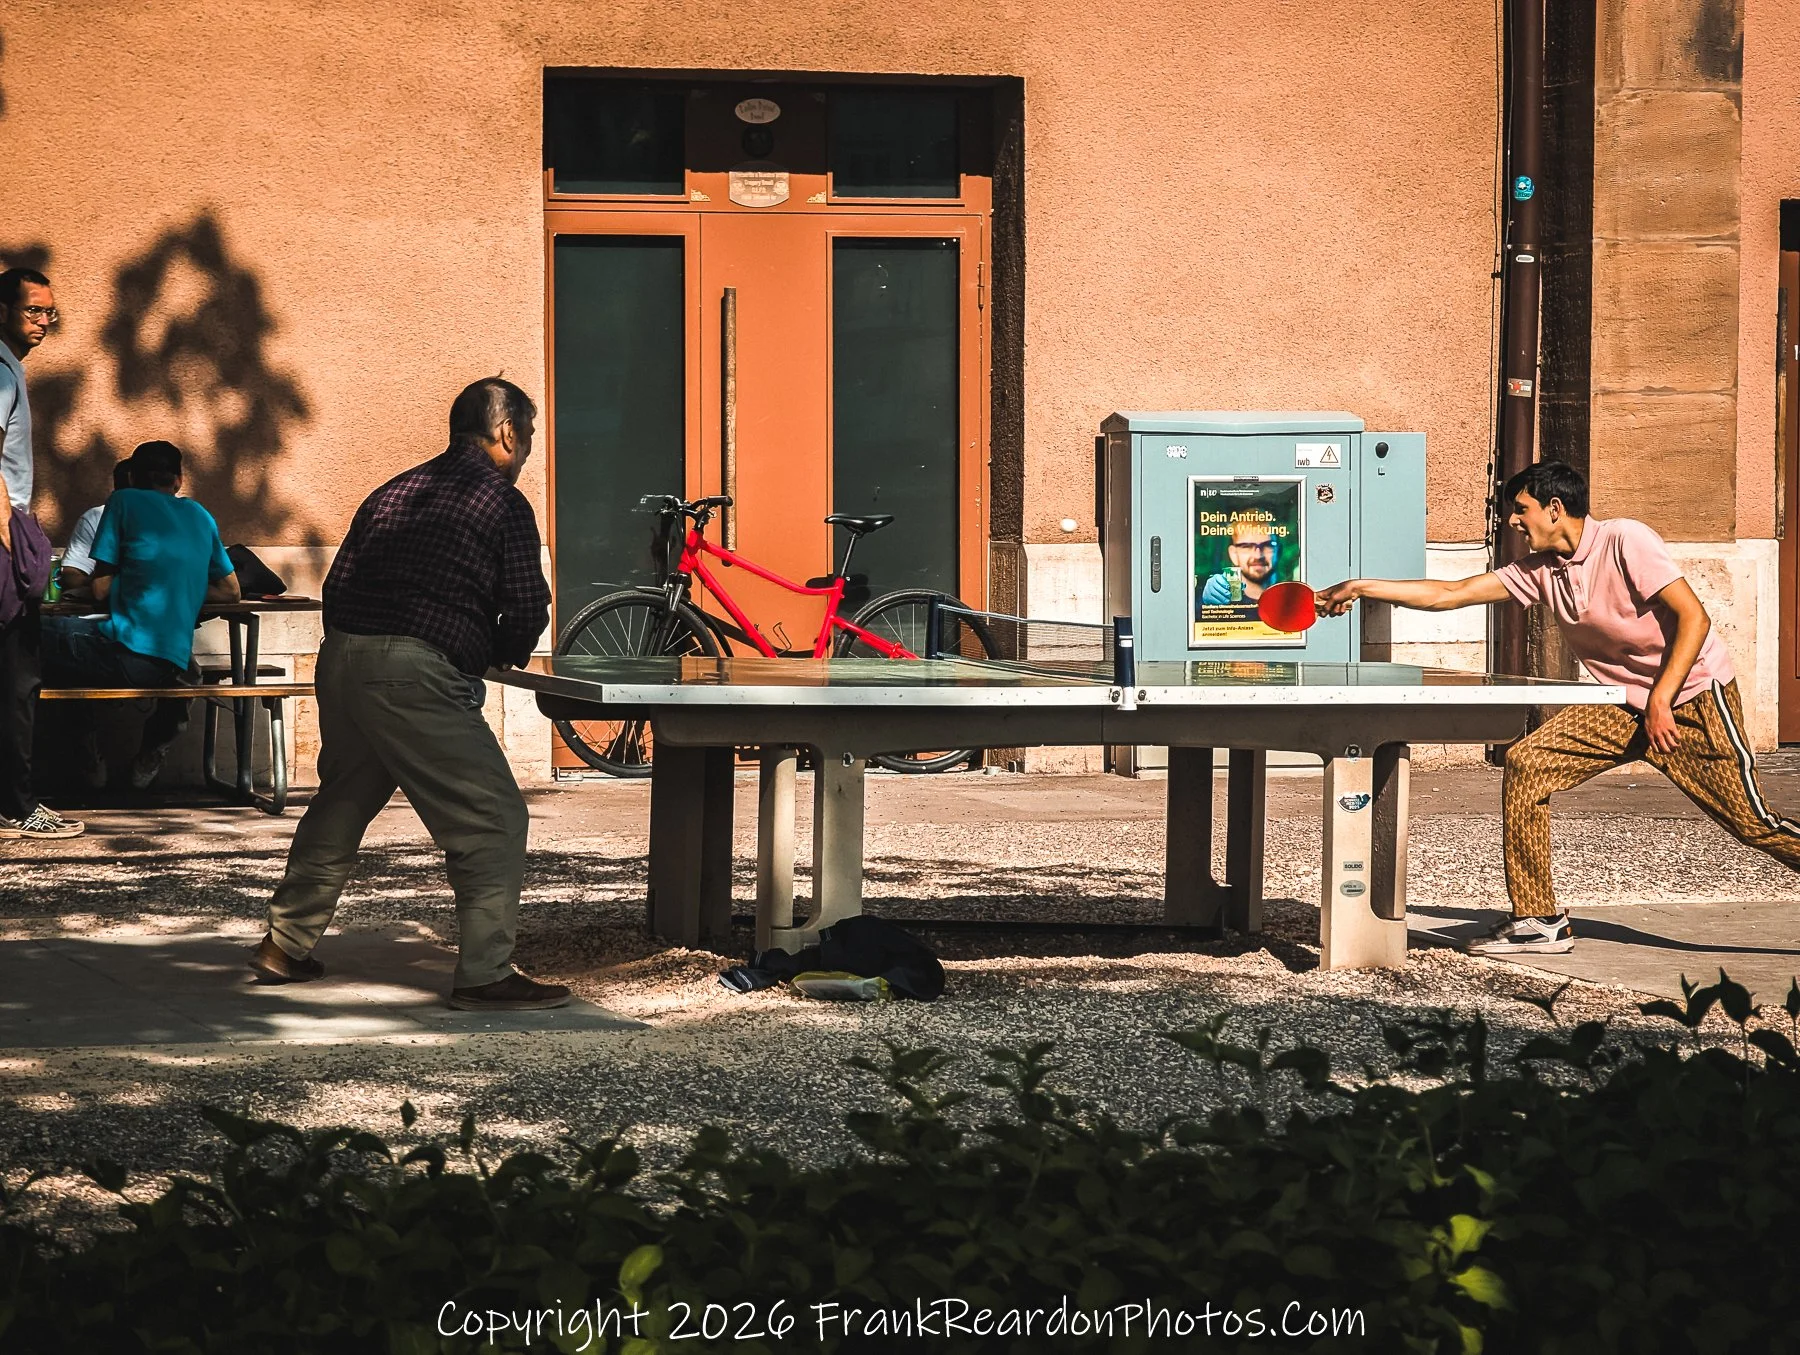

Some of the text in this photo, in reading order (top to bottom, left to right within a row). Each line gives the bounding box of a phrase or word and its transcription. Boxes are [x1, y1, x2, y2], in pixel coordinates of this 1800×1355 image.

[1200, 511, 1276, 522] Dein Antrieb.
[1201, 525, 1290, 537] Deine Wirkung.
